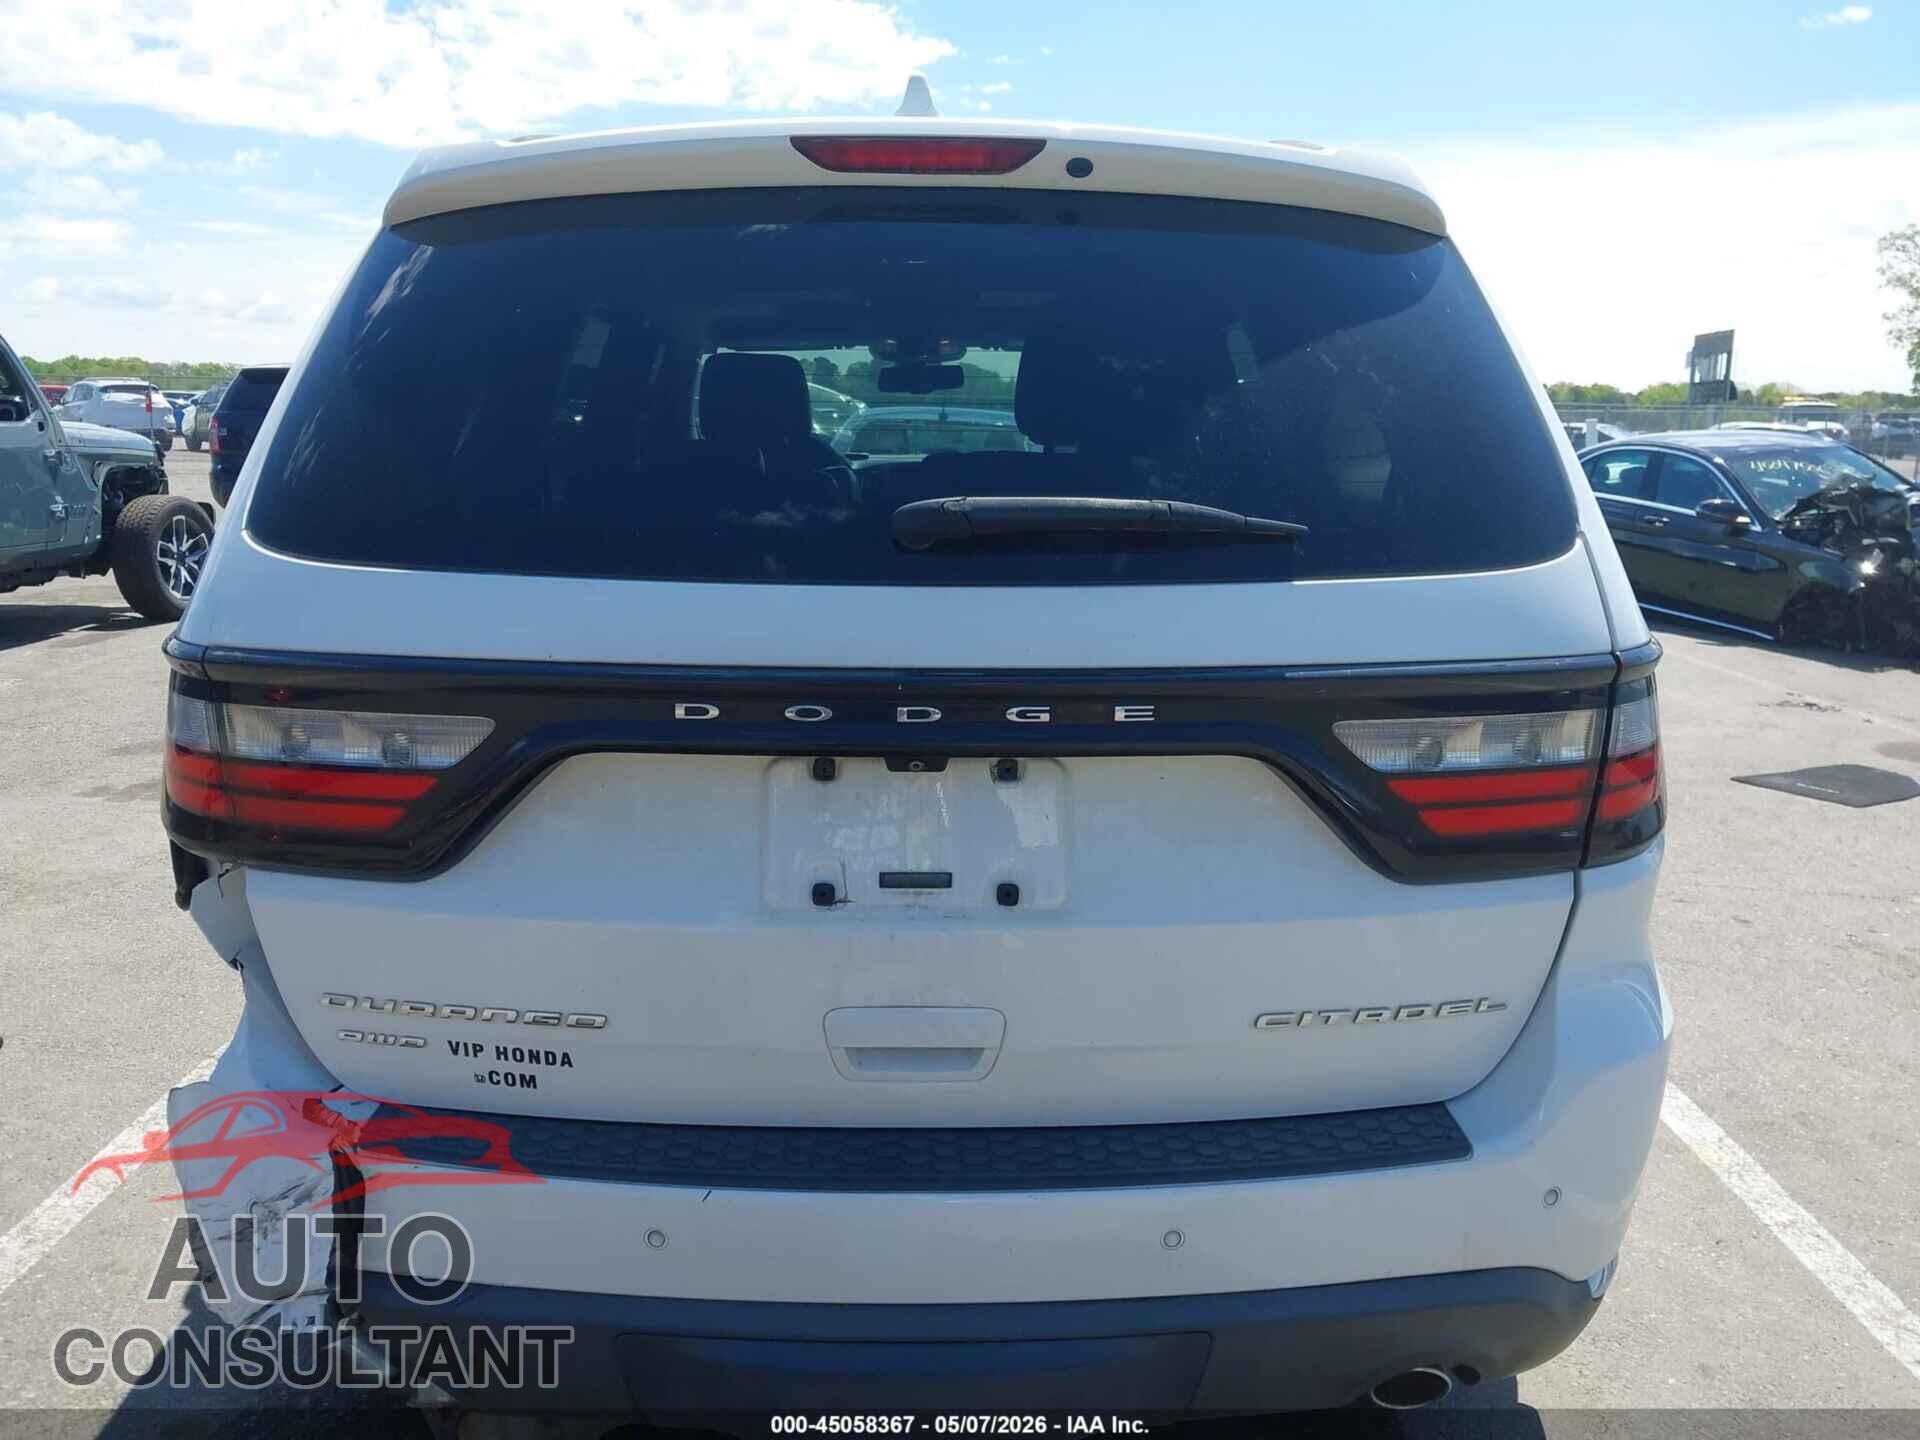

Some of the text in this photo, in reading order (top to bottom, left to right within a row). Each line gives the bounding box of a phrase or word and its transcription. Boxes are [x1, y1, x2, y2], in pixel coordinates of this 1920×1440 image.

[675, 703, 1155, 723] DODGE
[320, 992, 608, 1029] DURANGO
[1254, 997, 1507, 1030] CITADEL
[337, 1029, 427, 1048] AWD
[447, 1039, 574, 1068] VIP HONDA
